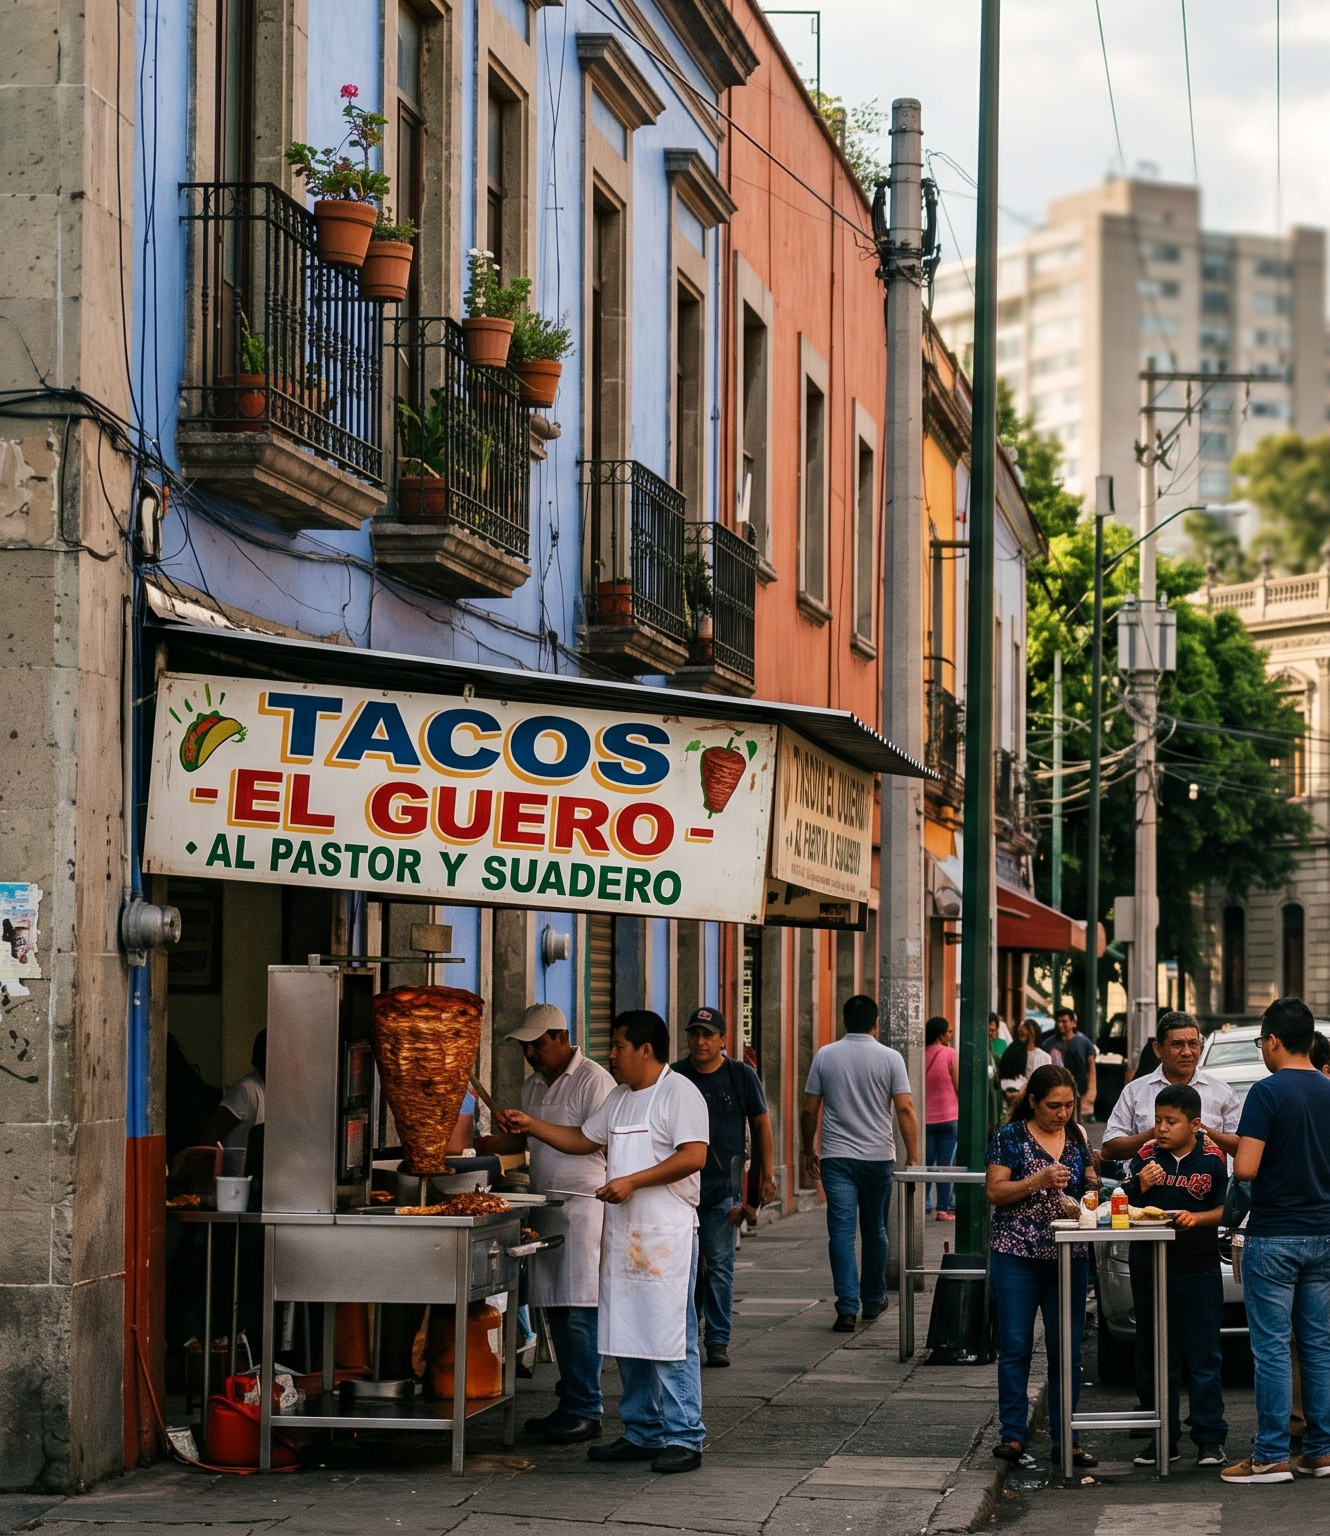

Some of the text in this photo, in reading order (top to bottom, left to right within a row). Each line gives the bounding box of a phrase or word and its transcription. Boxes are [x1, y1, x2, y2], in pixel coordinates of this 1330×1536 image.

[258, 692, 671, 795] TACOS
[205, 833, 682, 905] AL PASTOR Y SUADERO
